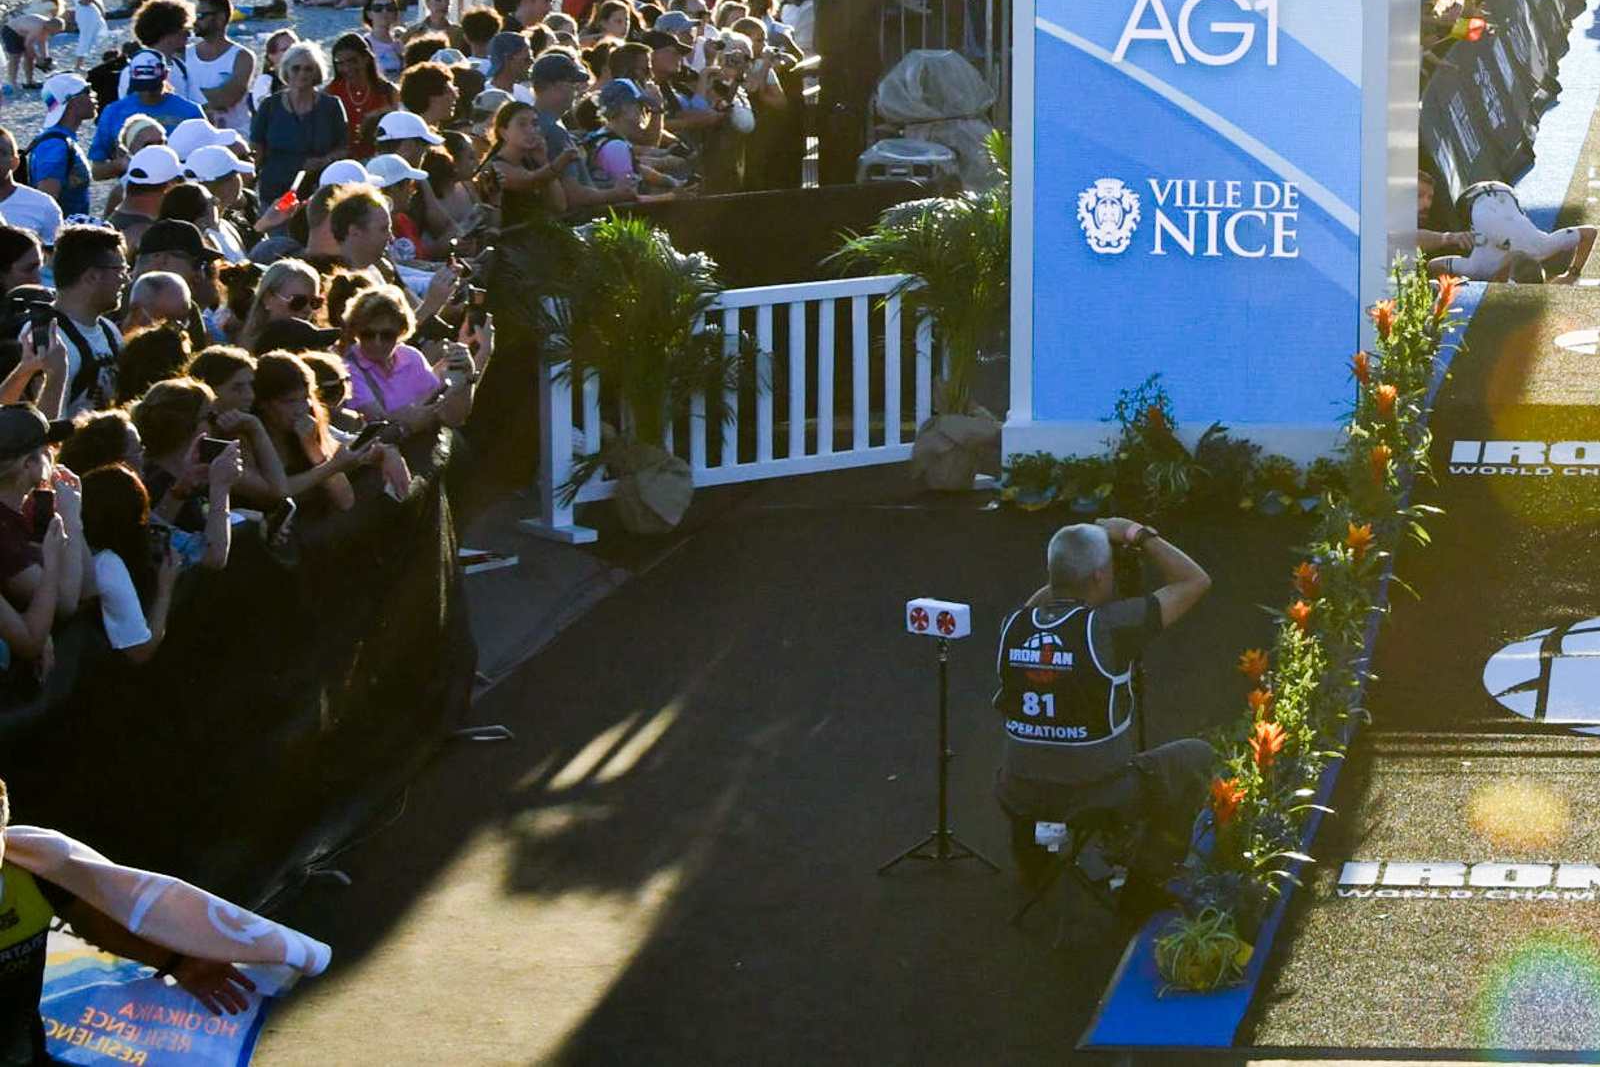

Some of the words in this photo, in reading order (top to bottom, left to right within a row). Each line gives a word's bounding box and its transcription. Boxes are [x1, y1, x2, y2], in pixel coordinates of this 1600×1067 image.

[1148, 179, 1243, 210] VILLE
[1255, 180, 1299, 210] DE
[1150, 211, 1299, 258] NICE
[1448, 466, 1553, 477] WORLD
[1022, 691, 1056, 718] 81
[1337, 888, 1474, 902] WORLD
